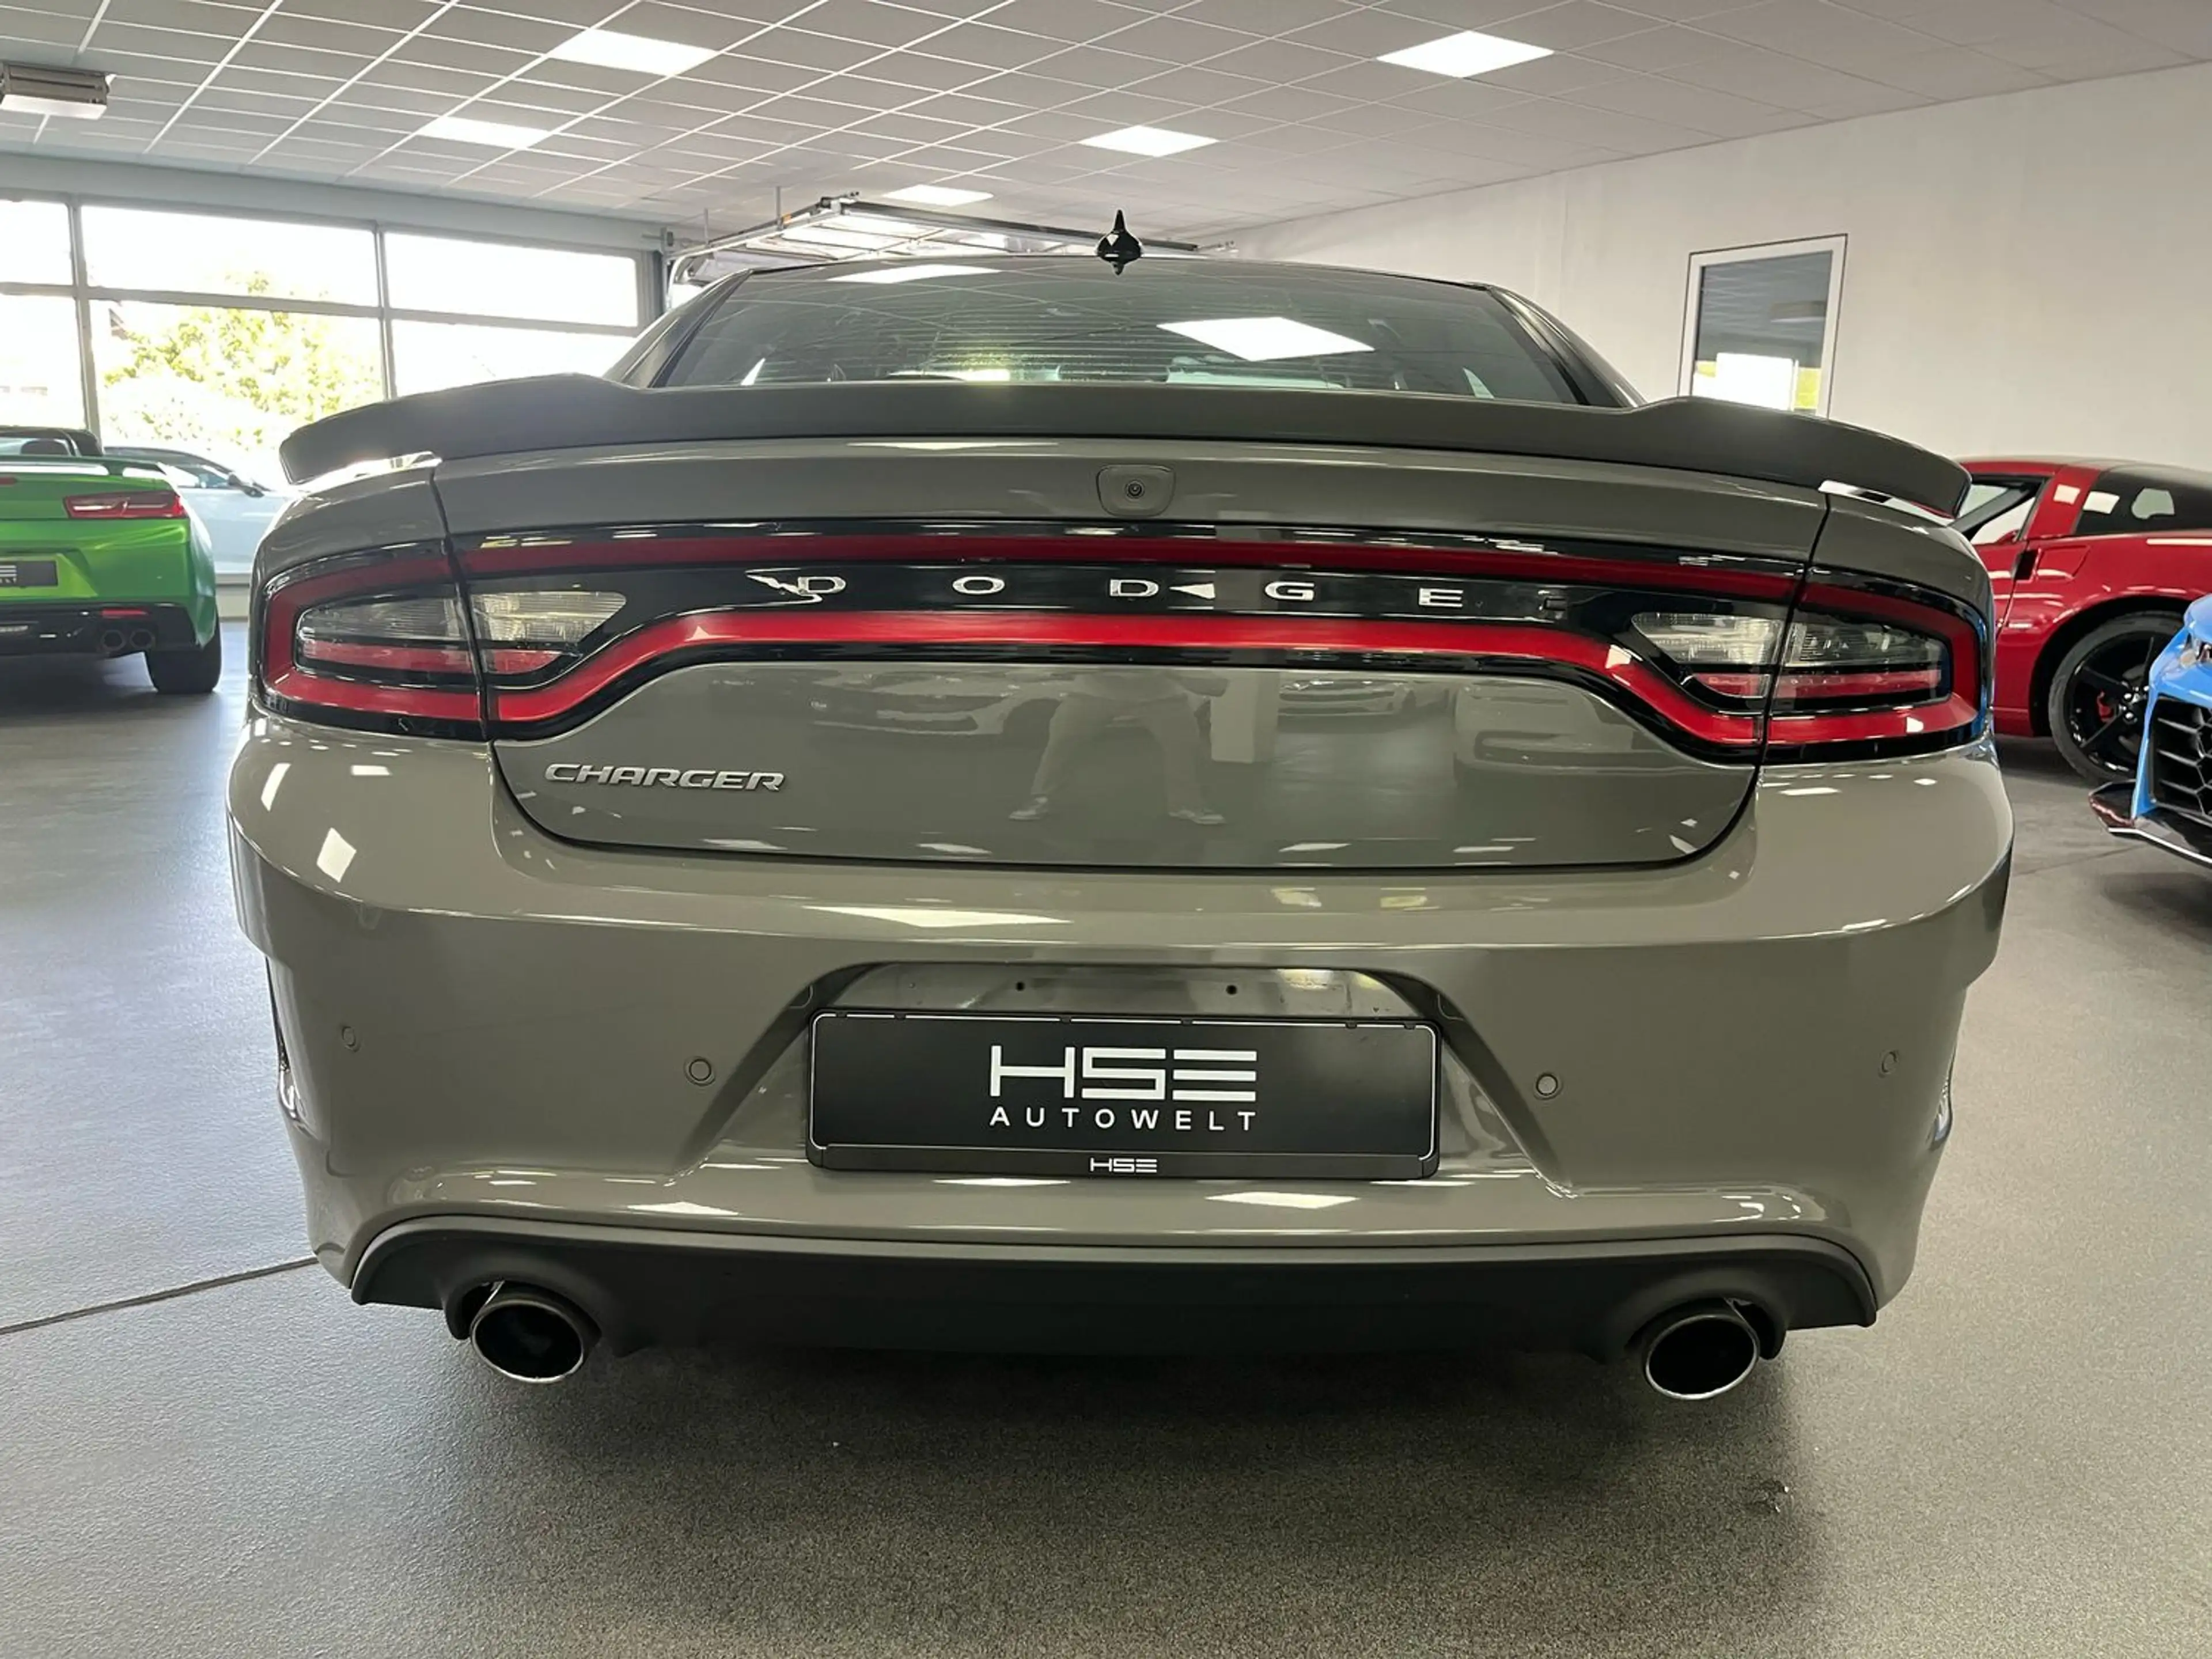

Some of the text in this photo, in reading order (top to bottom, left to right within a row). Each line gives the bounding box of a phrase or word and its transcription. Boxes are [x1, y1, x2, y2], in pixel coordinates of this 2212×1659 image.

[796, 576, 1464, 608] DODGE
[544, 763, 784, 791] CHARGER
[990, 1045, 1257, 1102] HSE
[990, 1106, 1256, 1131] AUTOWELT
[1090, 1157, 1157, 1173] HSE
